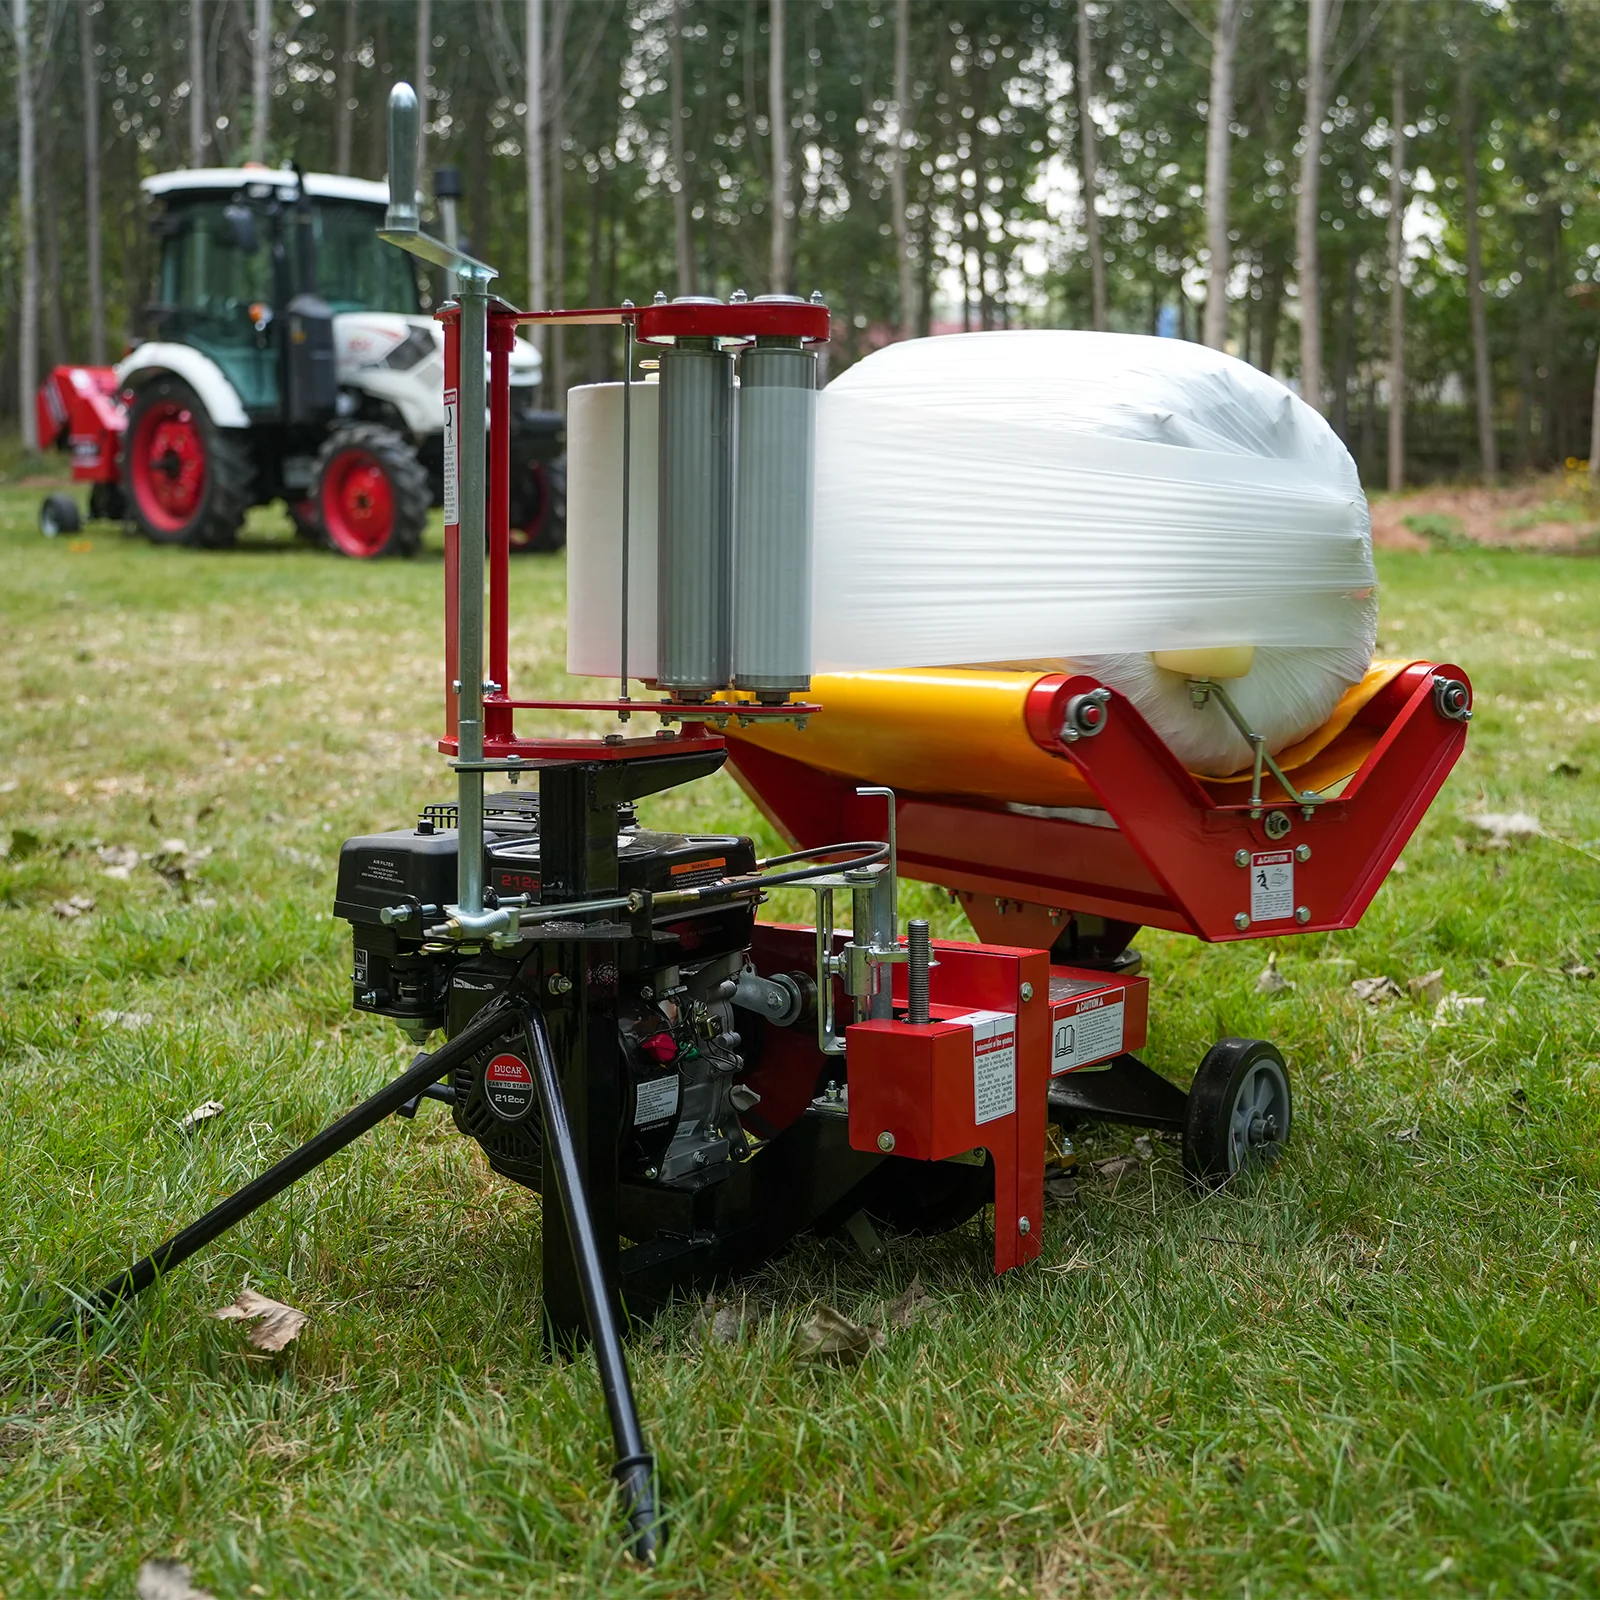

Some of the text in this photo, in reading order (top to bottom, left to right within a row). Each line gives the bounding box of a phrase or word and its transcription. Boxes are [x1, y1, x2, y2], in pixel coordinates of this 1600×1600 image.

[1264, 855, 1288, 864] CAUTION
[501, 875, 540, 889] 212c
[1080, 998, 1099, 1011] CAUTION
[494, 1065, 522, 1074] DUCAR
[495, 1094, 525, 1104] 212cc
